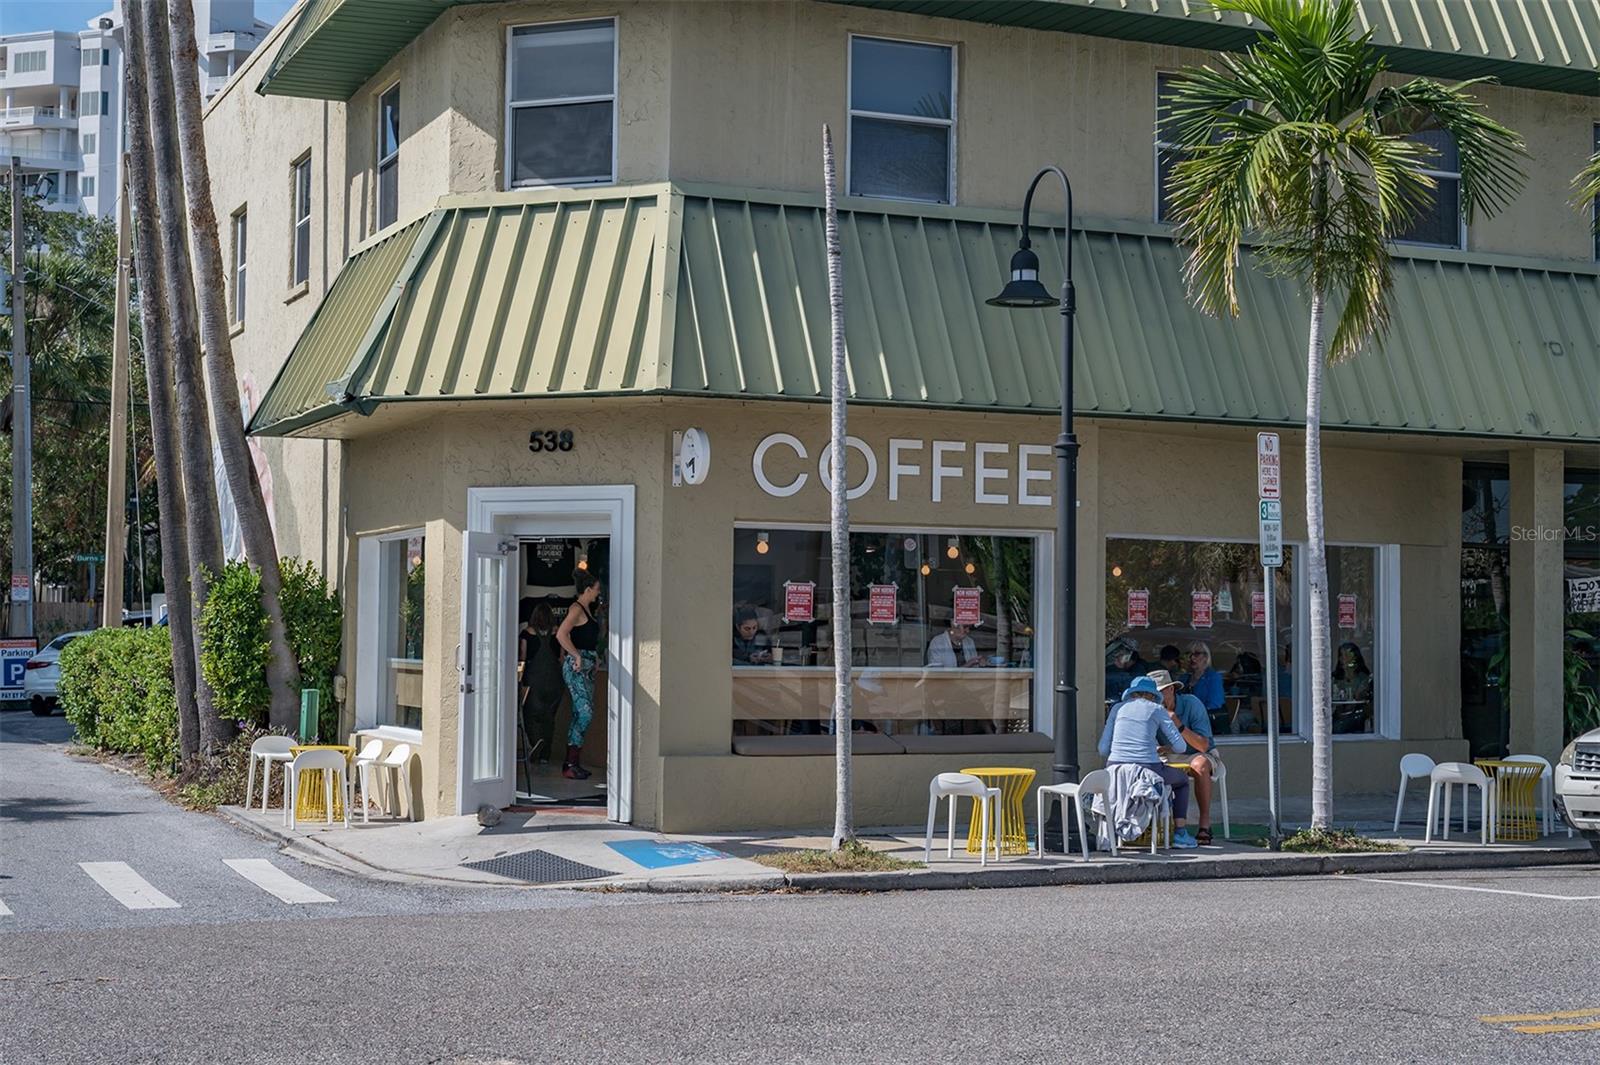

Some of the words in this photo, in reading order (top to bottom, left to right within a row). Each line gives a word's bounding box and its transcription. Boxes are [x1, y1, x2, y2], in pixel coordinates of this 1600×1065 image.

[528, 429, 574, 452] 538
[1264, 439, 1273, 452] NO
[1260, 453, 1279, 466] PARKING
[752, 432, 1052, 506] COFFEE
[1261, 503, 1267, 518] 3
[1, 649, 34, 657] Parking
